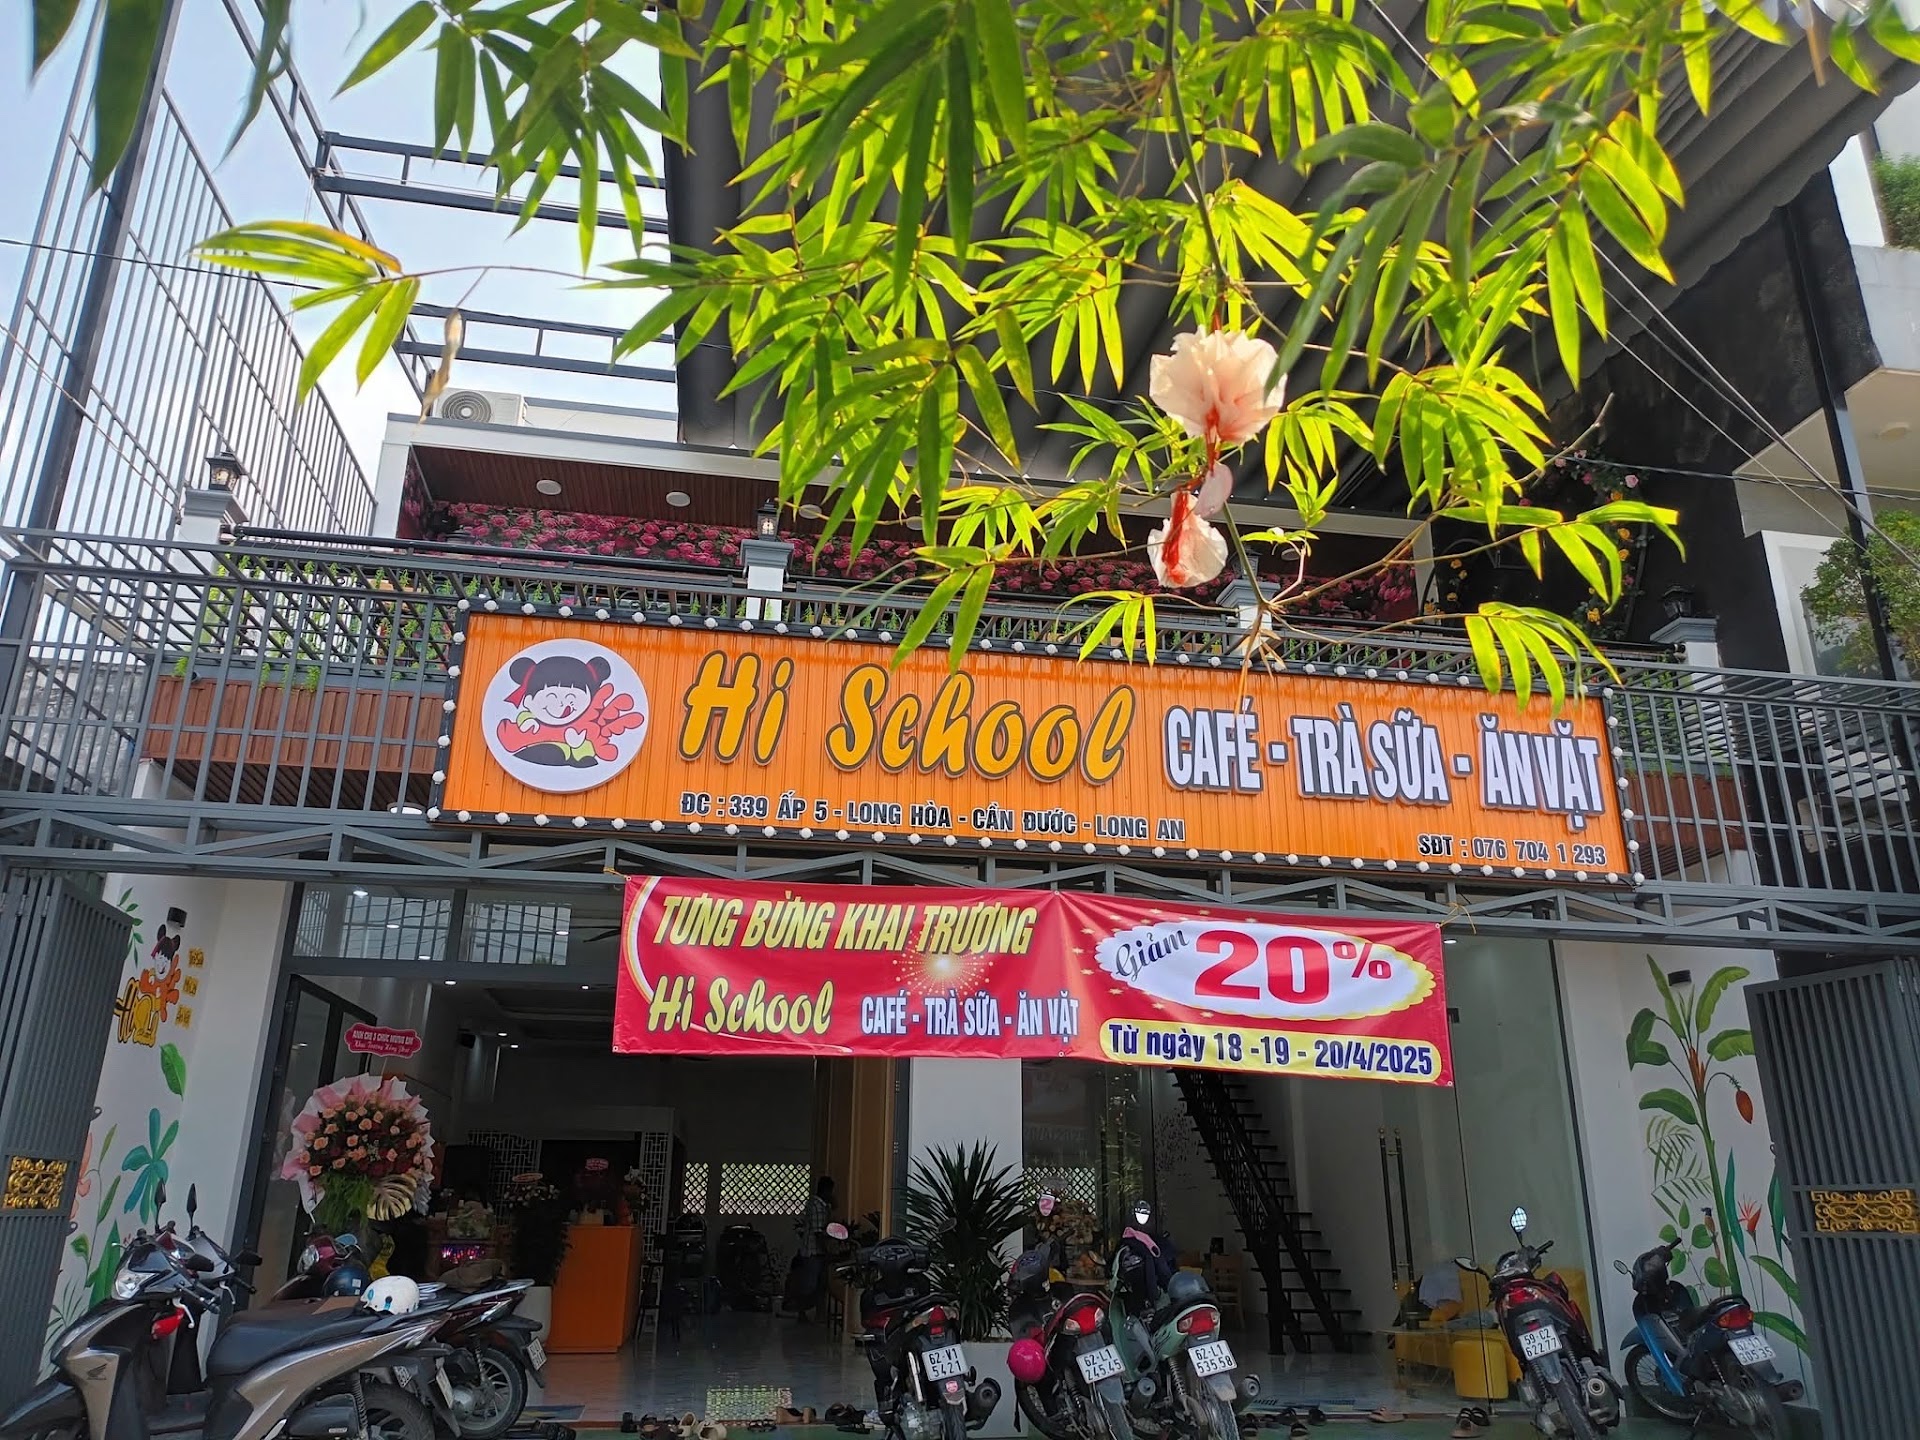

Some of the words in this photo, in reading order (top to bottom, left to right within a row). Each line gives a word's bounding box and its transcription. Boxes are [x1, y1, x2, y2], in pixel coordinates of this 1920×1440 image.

[678, 649, 794, 766] Hi
[826, 662, 1136, 786] School
[1165, 696, 1263, 796] CAFÉ
[1289, 701, 1370, 801] TRÀ
[1371, 709, 1452, 808] SỮA
[1476, 712, 1537, 813] ĂN
[1531, 719, 1606, 834] VẶT
[680, 792, 711, 816] ĐC
[729, 794, 769, 819] 339
[776, 790, 807, 821] ẤP
[814, 799, 828, 822] 5
[846, 800, 901, 826] LONG
[910, 800, 951, 829] HÒA
[972, 801, 1014, 833] CẦN
[1022, 806, 1077, 836] ĐƯỚC
[1095, 813, 1148, 841] LONG
[1155, 818, 1186, 843] AN
[1417, 832, 1454, 857] SĐT
[1471, 838, 1507, 862] 076
[1515, 840, 1550, 864] 704
[1556, 843, 1567, 863] 1
[1572, 844, 1607, 868] 293
[653, 892, 744, 948] TƯNG
[740, 890, 836, 950] BỪNG
[834, 902, 916, 952] KHAI
[916, 901, 1038, 955] TRƯƠNG
[1115, 927, 1190, 982] Giảm
[1194, 929, 1392, 1005] 20%
[647, 975, 695, 1033] Hi
[704, 976, 835, 1035] School
[861, 989, 907, 1035] CAFÉ
[925, 989, 959, 1036] TRÀ
[963, 991, 1000, 1037] SỮA
[1017, 991, 1043, 1037] ĂN
[1047, 990, 1079, 1043] VẶT
[1108, 1024, 1139, 1055] Từ
[1146, 1029, 1205, 1062] ngày
[1213, 1032, 1242, 1062] 18
[1314, 1040, 1433, 1076] 20/4/2025
[928, 1348, 958, 1365] 62-V1
[932, 1361, 961, 1378] 5421
[1083, 1349, 1113, 1367] 62-L1
[1085, 1359, 1122, 1381] 245.45
[1194, 1344, 1224, 1361] 62-L1
